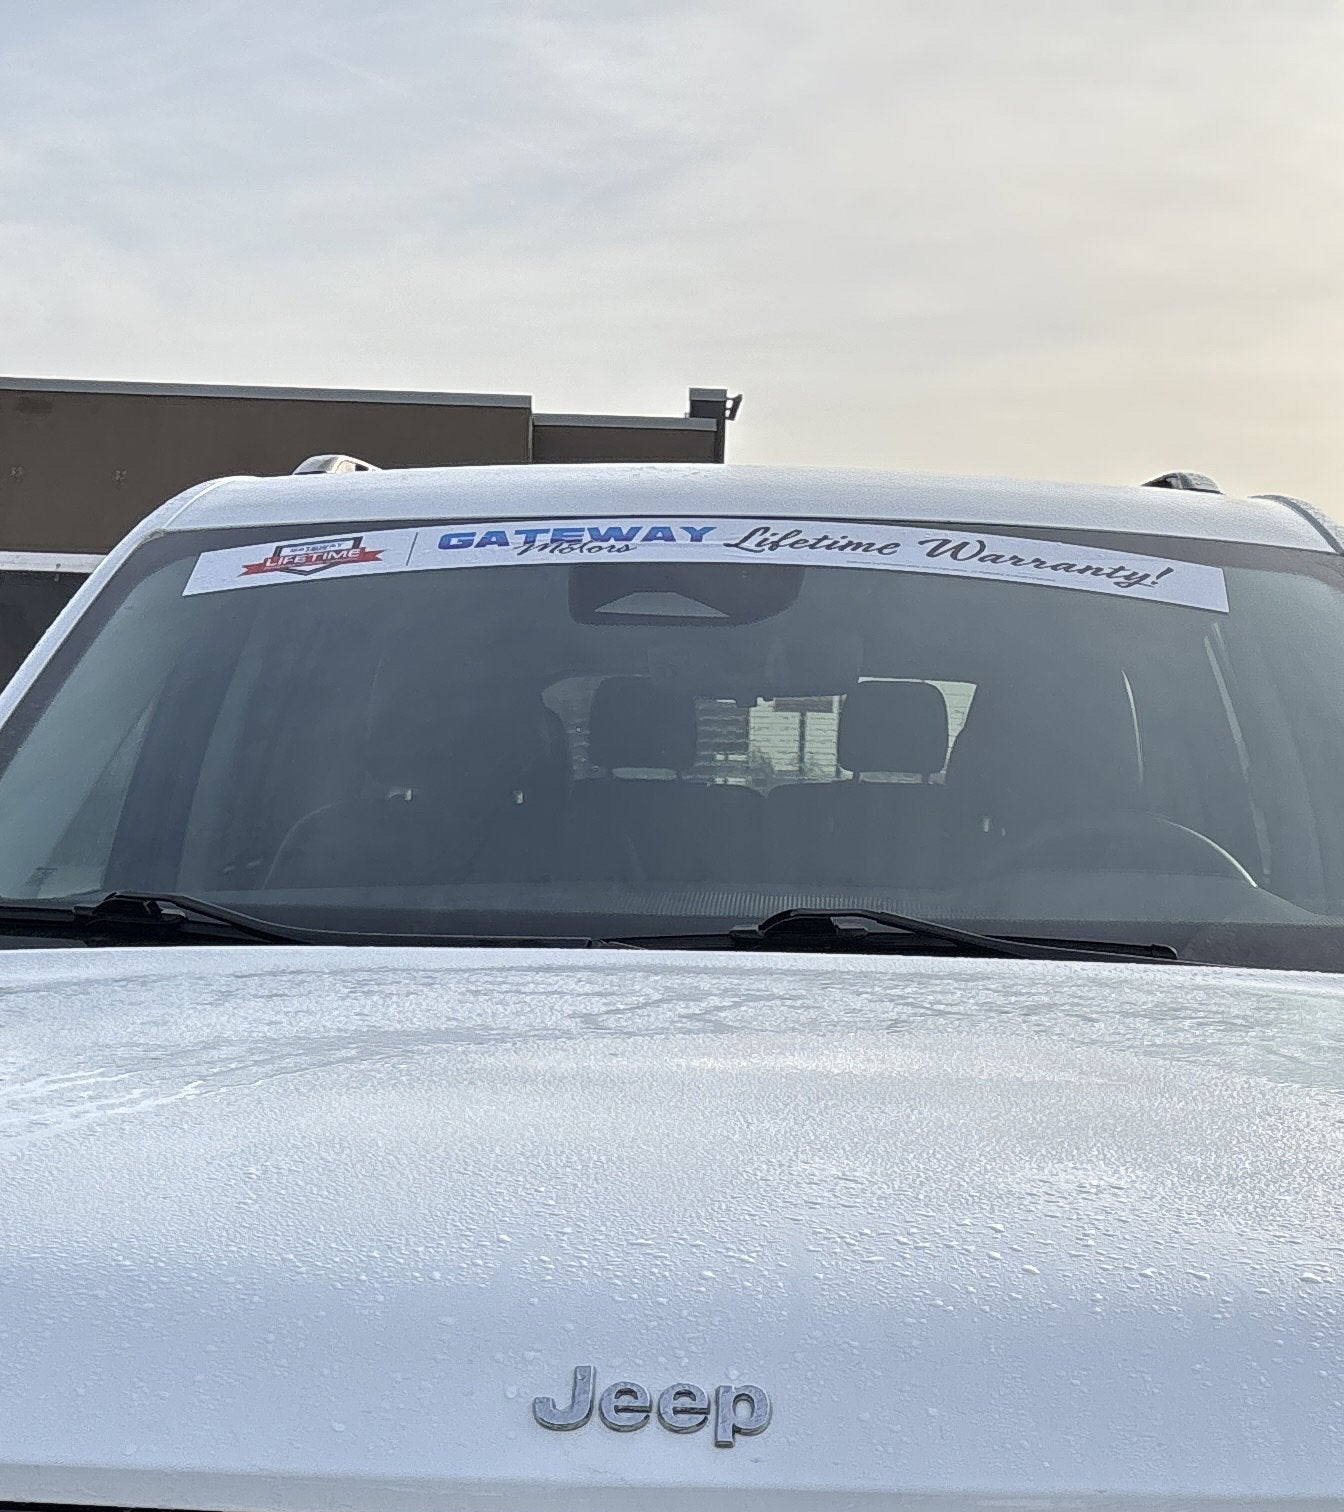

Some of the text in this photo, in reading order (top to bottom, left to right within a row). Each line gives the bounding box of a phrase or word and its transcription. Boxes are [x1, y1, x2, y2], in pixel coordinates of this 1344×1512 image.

[437, 526, 717, 549] GATEWAY
[514, 540, 637, 556] Motors
[265, 549, 360, 567] LIFETIME
[723, 526, 900, 555] Lifetime
[918, 538, 1174, 588] Warranty!
[532, 1365, 773, 1449] Jeep
